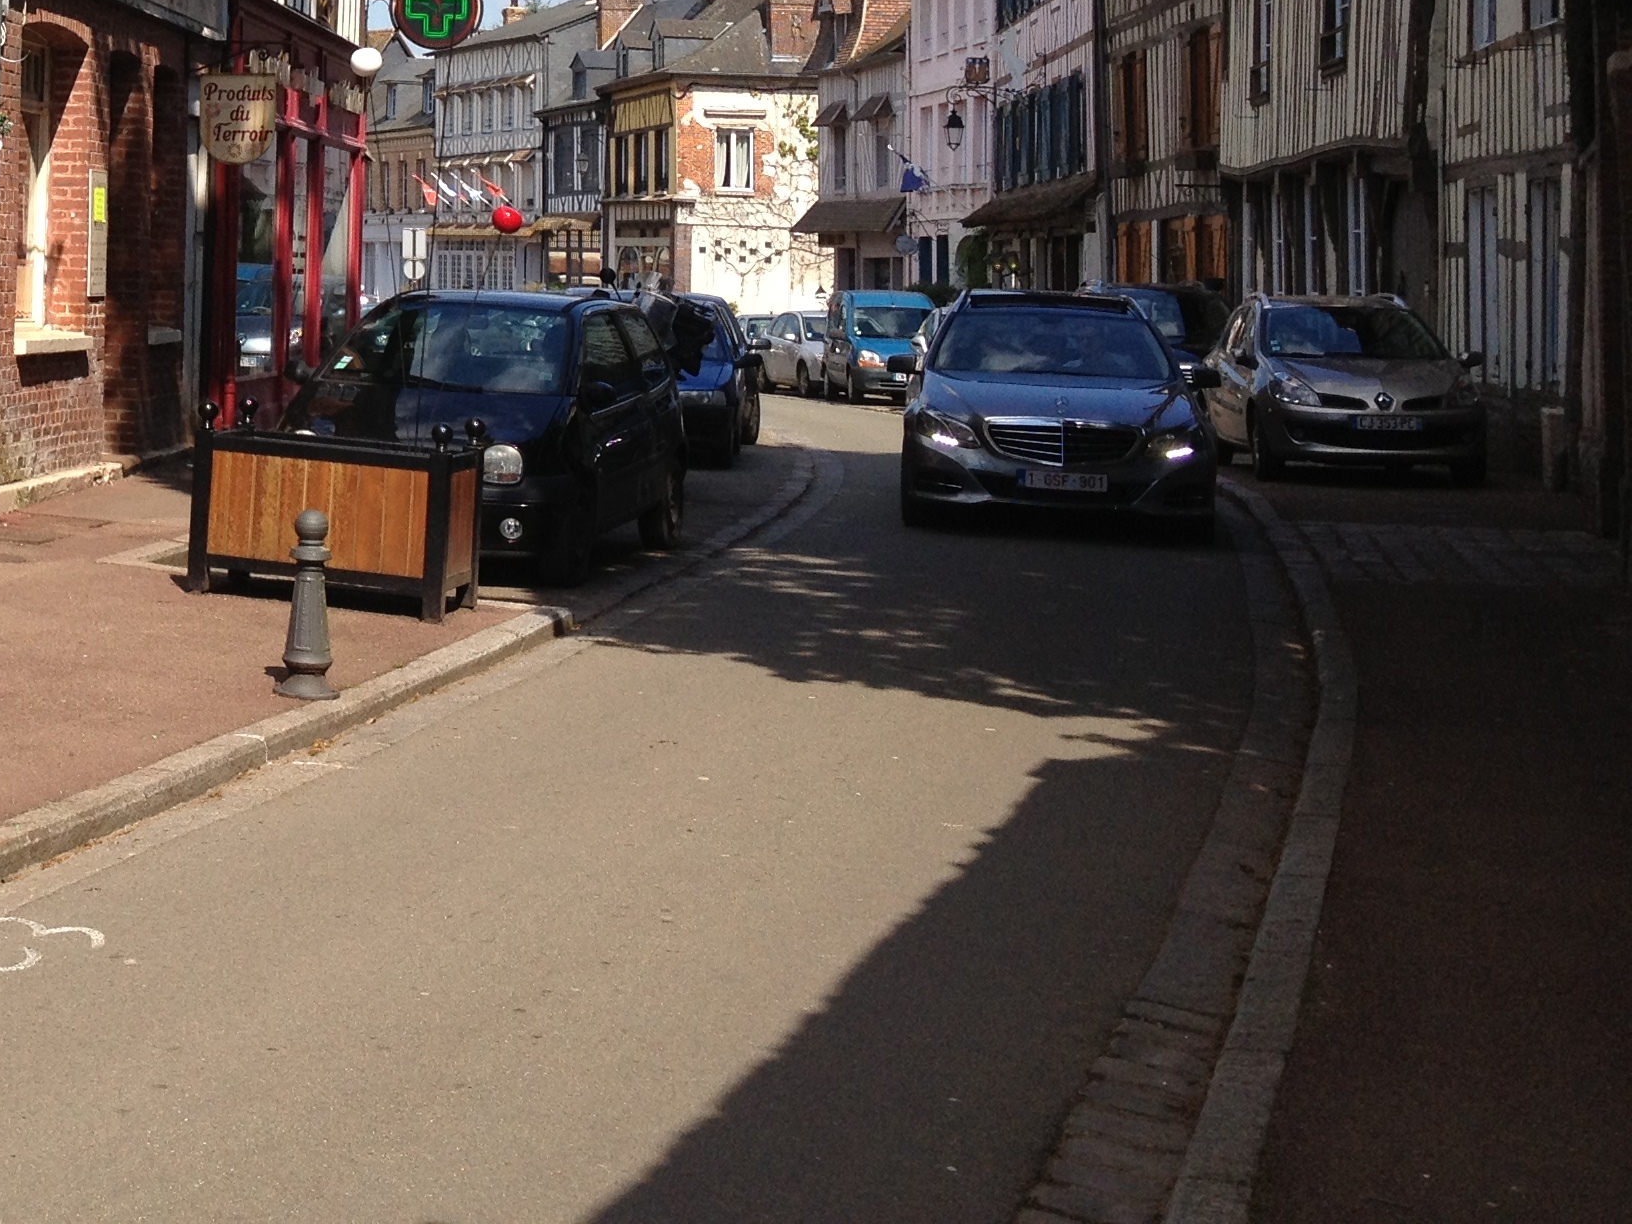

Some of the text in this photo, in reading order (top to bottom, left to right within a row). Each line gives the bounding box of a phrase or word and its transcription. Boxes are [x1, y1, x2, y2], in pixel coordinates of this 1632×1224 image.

[203, 83, 276, 102] Produits
[230, 105, 251, 122] du
[212, 122, 274, 142] Terroir
